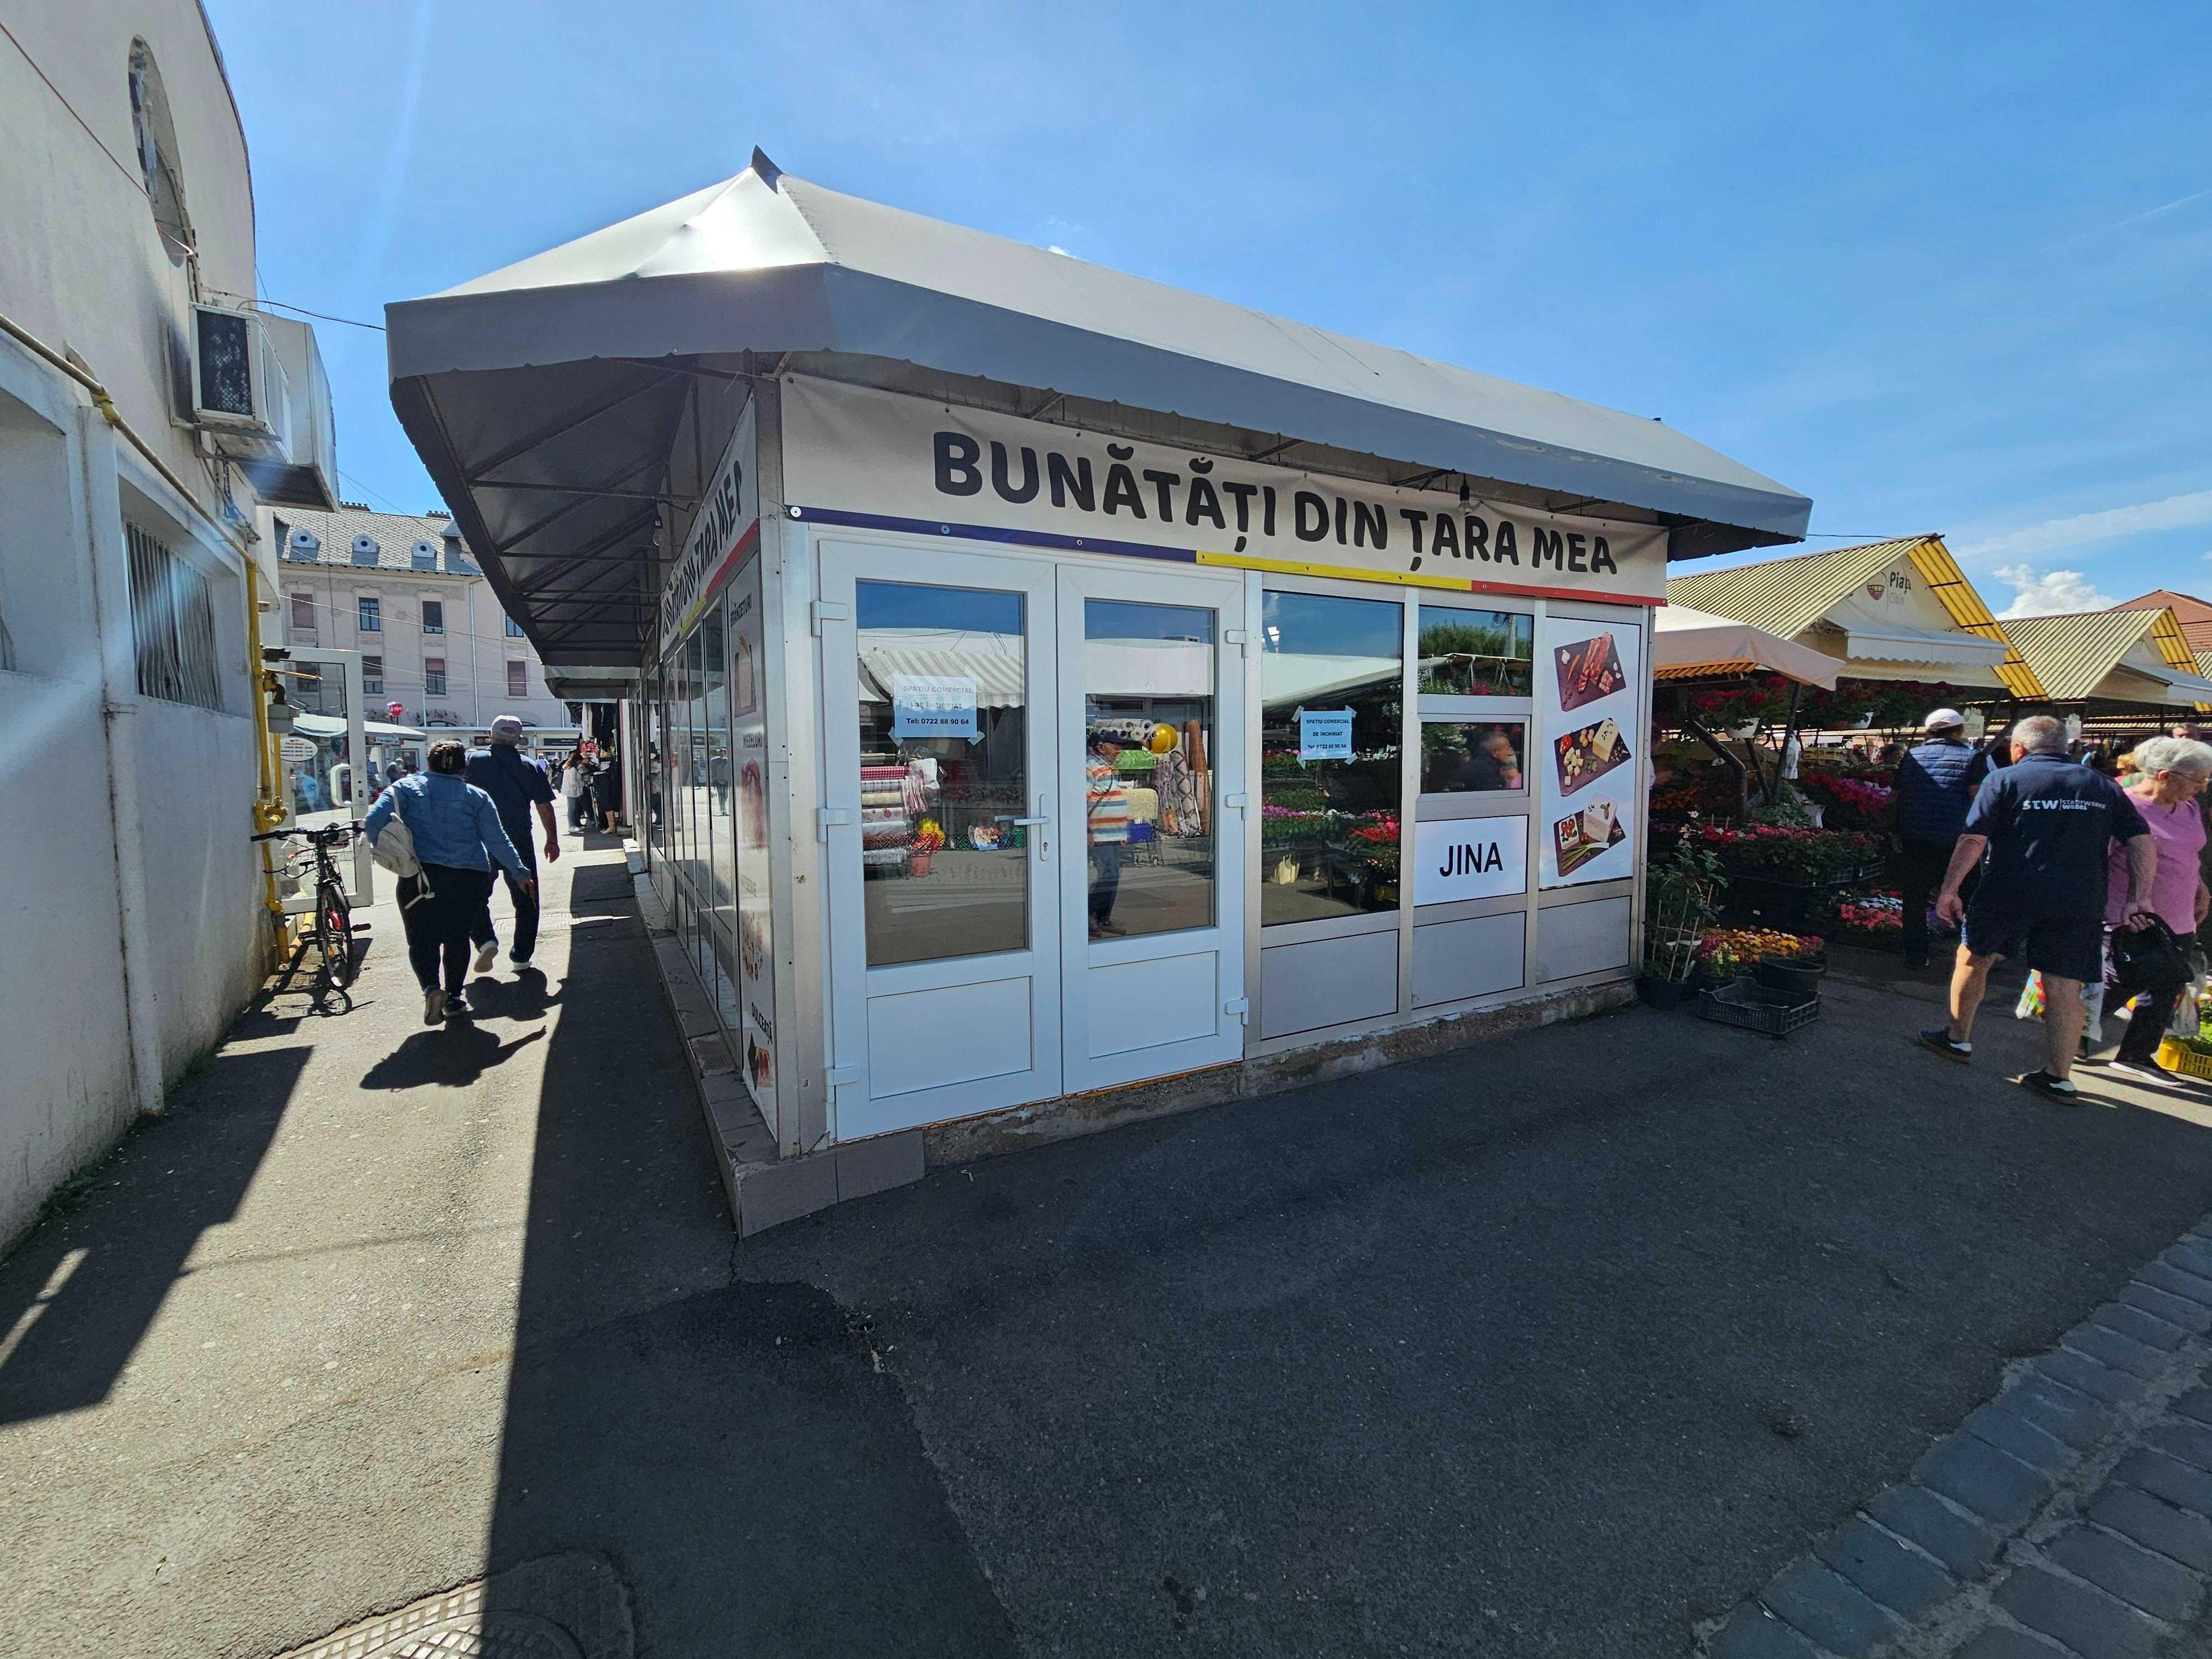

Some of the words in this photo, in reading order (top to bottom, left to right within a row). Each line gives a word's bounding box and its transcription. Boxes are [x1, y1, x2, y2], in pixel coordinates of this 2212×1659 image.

[933, 431, 1275, 553] BUNĂTĂȚI
[1294, 491, 1388, 550] DIN
[1399, 509, 1520, 572] ȚARA
[1531, 526, 1618, 575] MEA
[2022, 800, 2059, 810] STW
[1439, 842, 1504, 878] JINA
